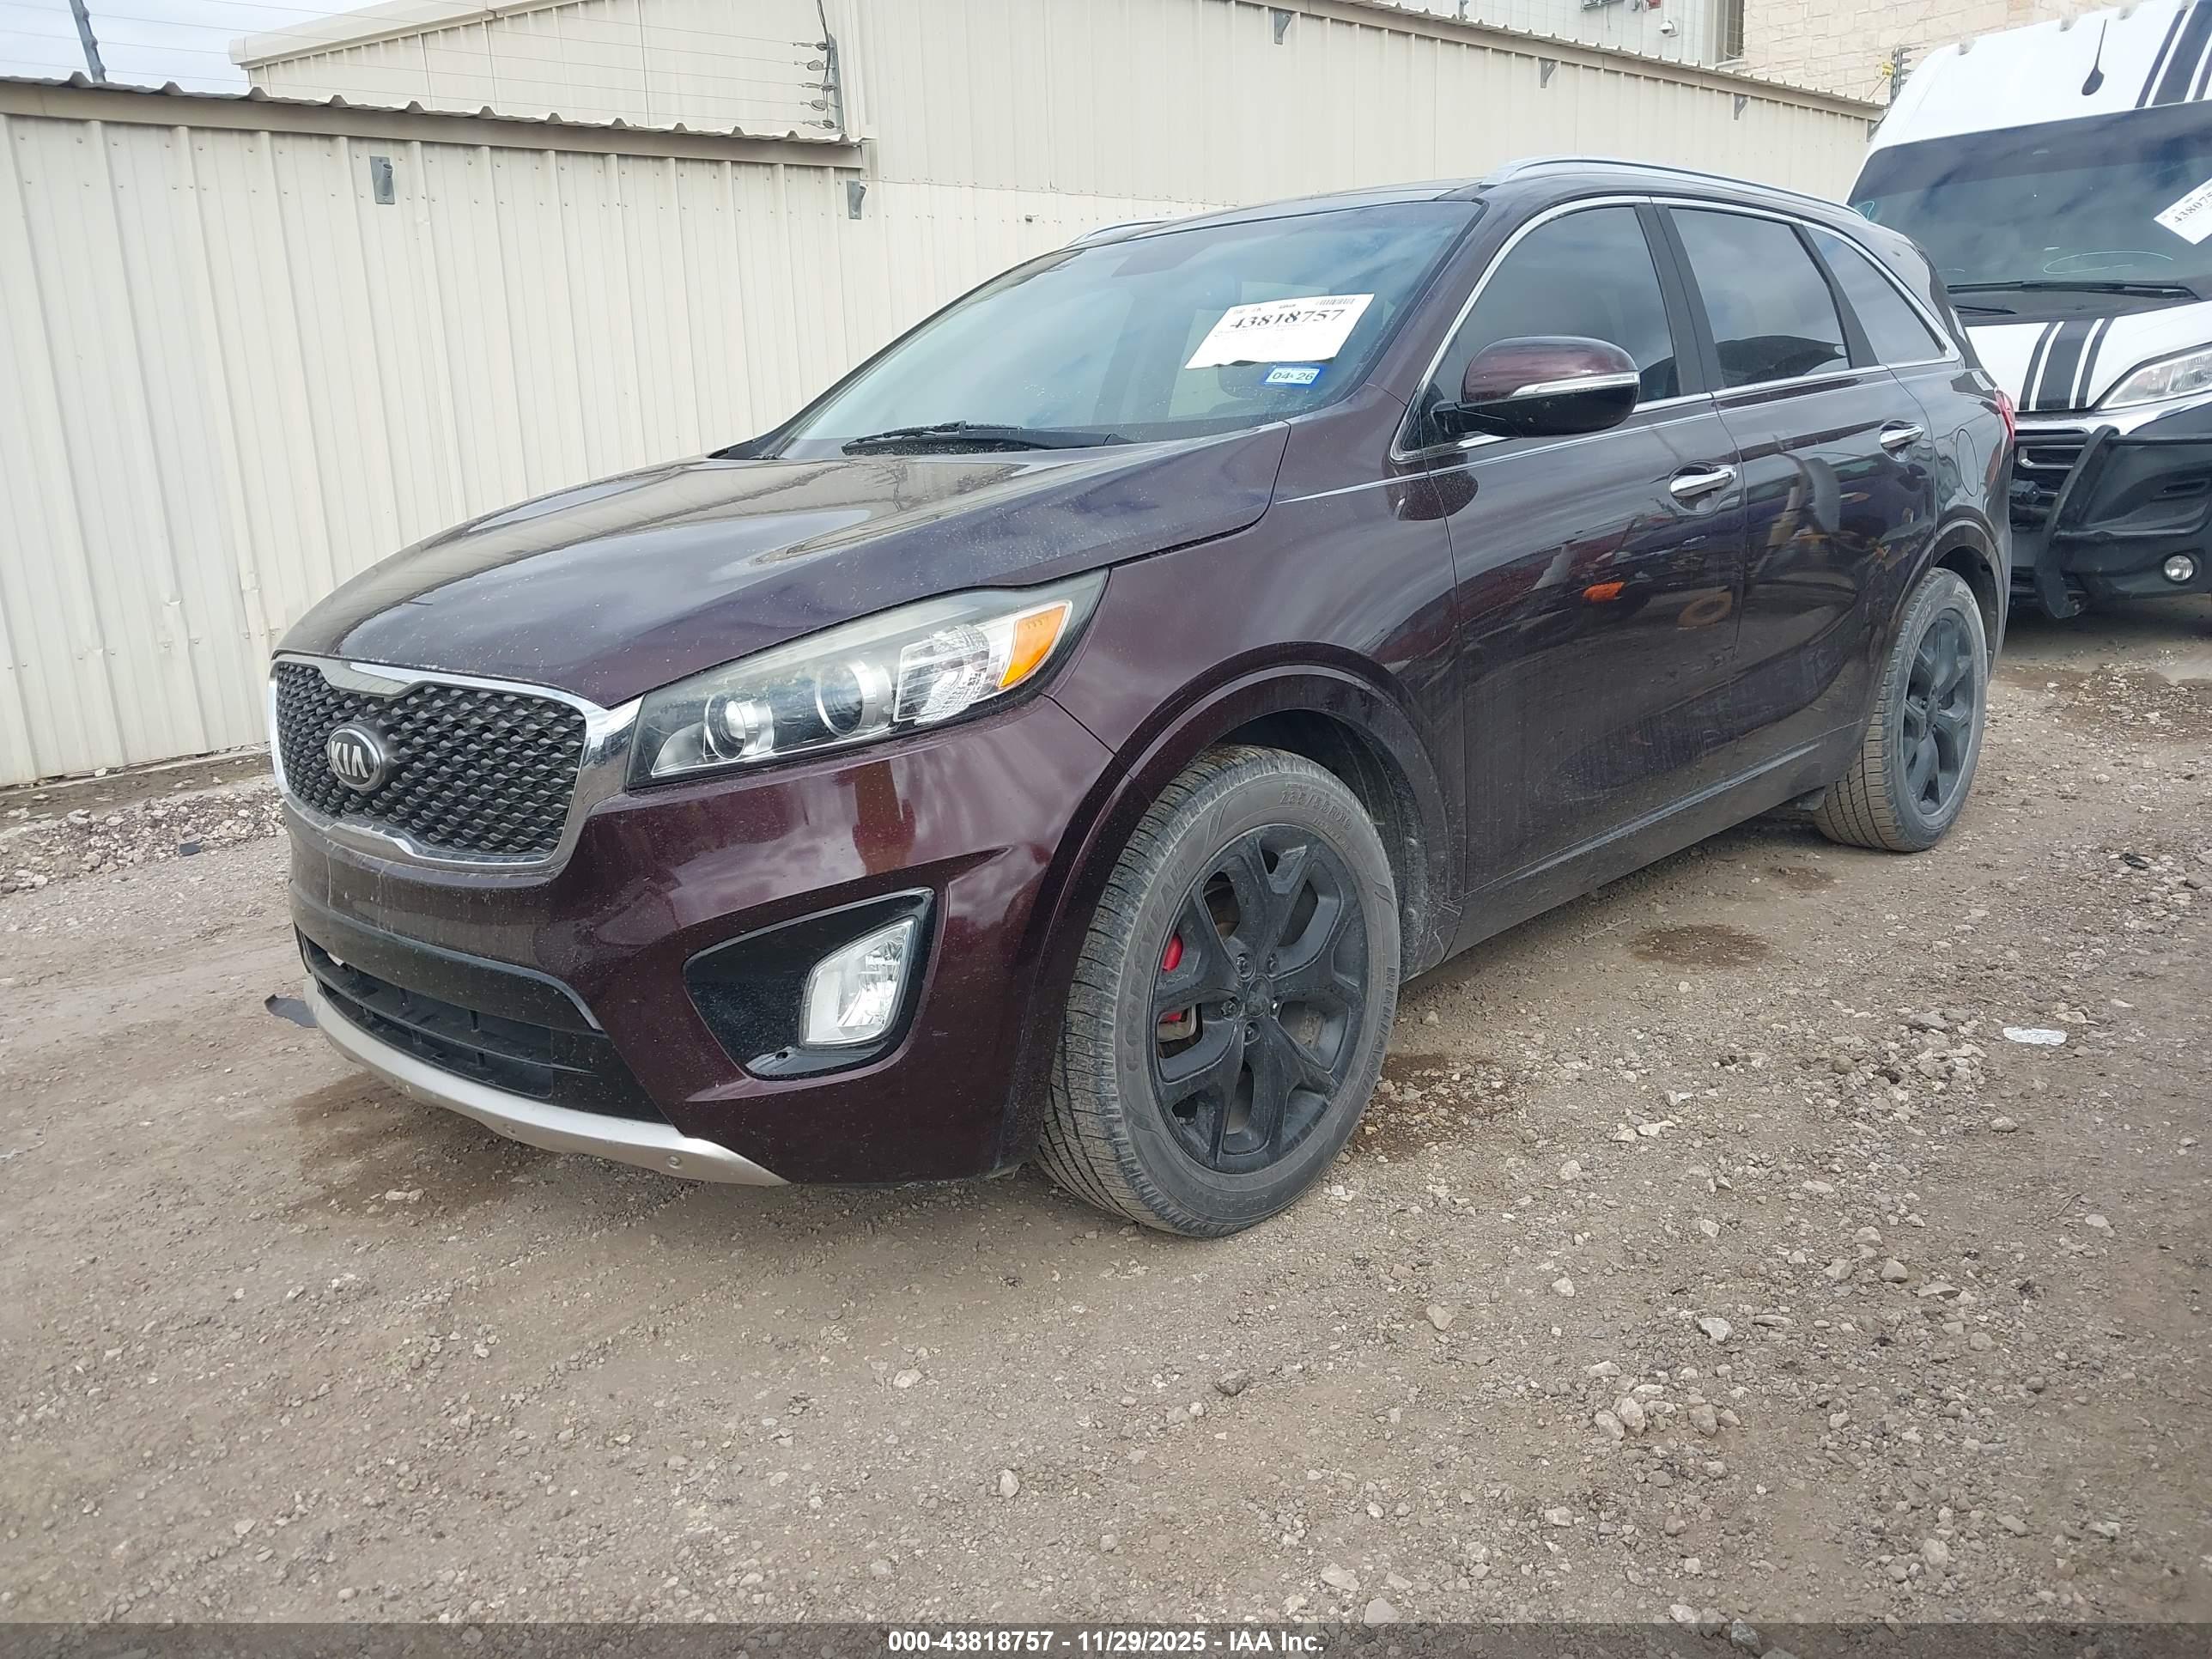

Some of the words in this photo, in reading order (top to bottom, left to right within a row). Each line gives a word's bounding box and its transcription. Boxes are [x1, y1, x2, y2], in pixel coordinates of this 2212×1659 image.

[1230, 308, 1346, 330] 43818757
[1272, 371, 1291, 380] 04
[1296, 371, 1316, 380] 26
[330, 740, 369, 779] KIA
